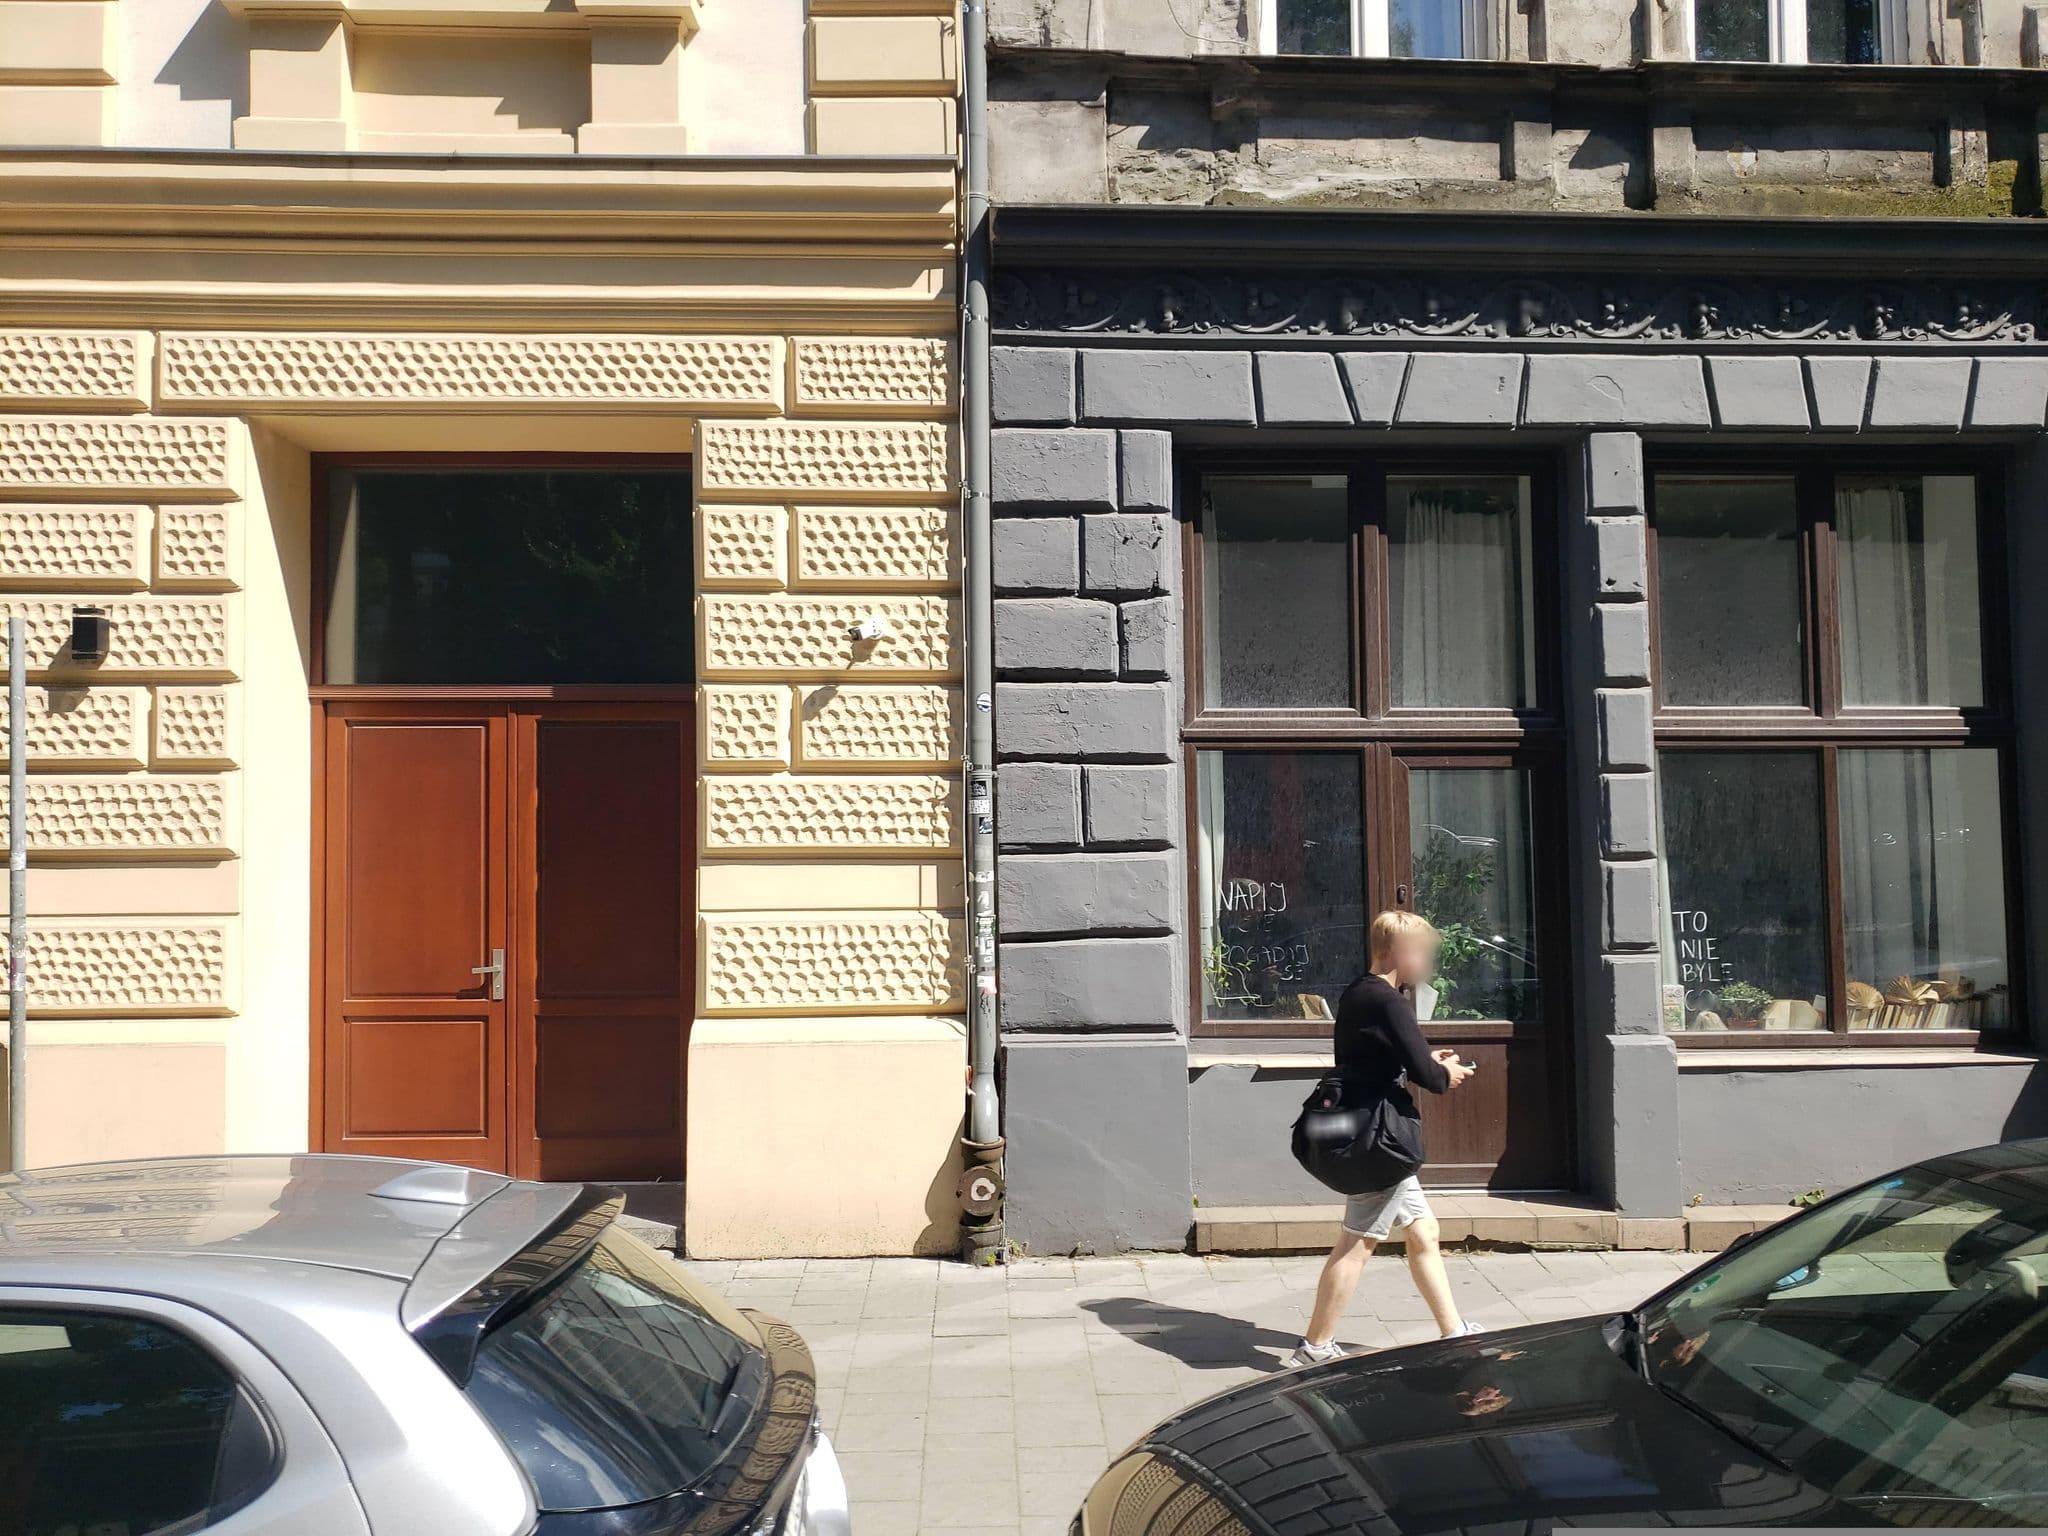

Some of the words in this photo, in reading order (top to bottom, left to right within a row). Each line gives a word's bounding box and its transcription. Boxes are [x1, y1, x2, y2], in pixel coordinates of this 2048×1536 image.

[1218, 881, 1288, 913] NAPIJ
[1672, 910, 1708, 933] TO
[1680, 937, 1720, 960] NIE
[1682, 962, 1734, 983] BYLE
